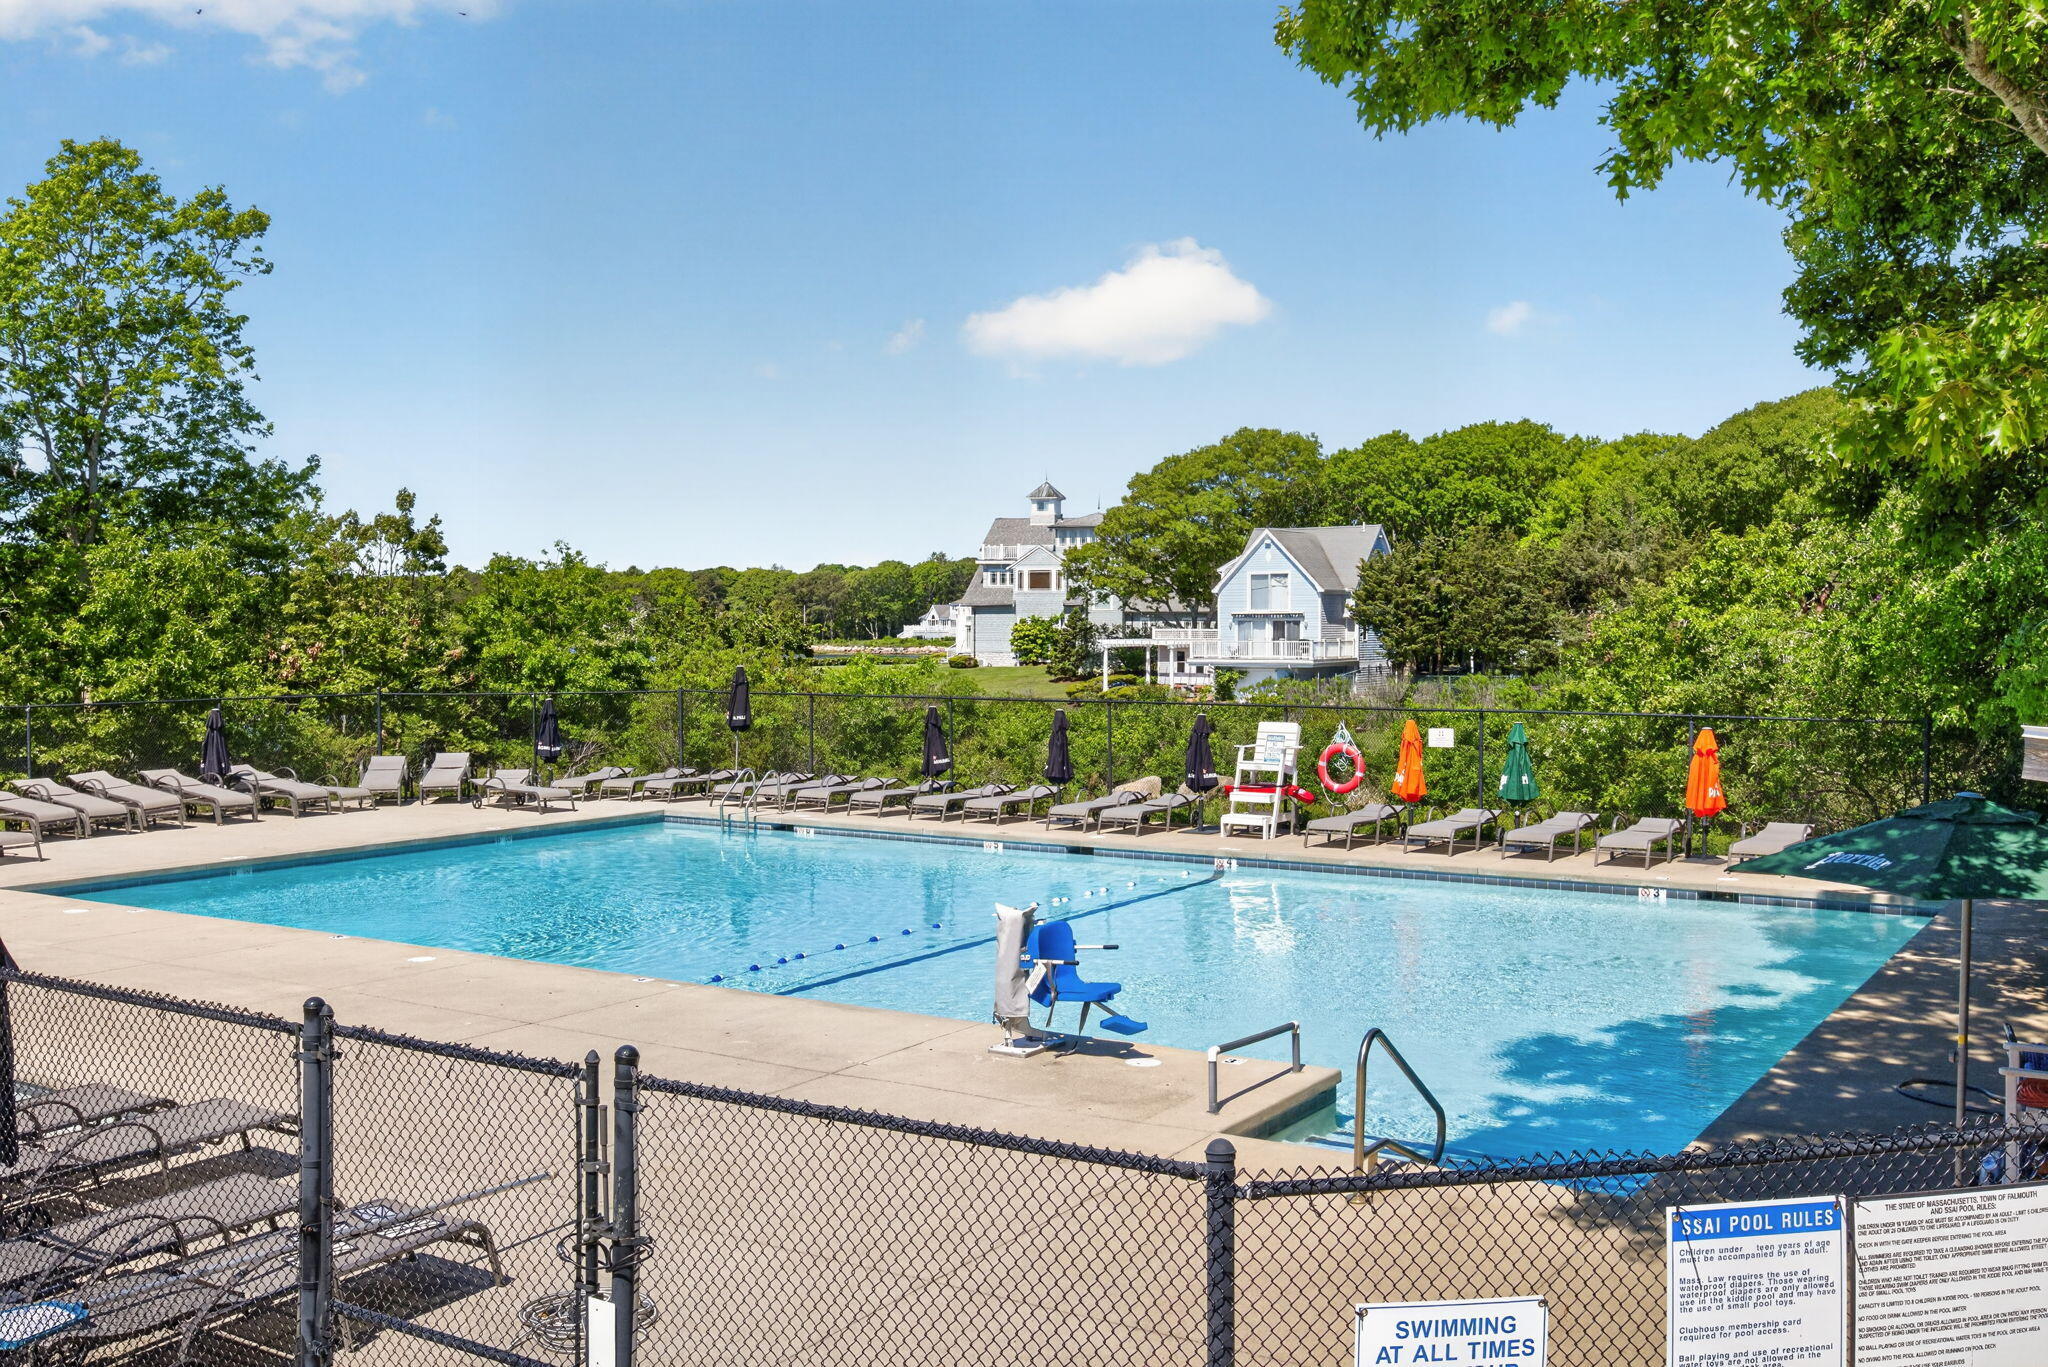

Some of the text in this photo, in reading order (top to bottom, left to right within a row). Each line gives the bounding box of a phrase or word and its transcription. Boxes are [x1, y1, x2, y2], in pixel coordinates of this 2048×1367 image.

[1653, 888, 1660, 898] 3
[1899, 1202, 1916, 1210] STATE
[1980, 1194, 1997, 1202] TOWN
[2008, 1191, 2037, 1200] FALMOUTH
[1682, 1210, 1833, 1236] SSAI POOL RULES
[1680, 1247, 1715, 1257] Children
[1719, 1246, 1743, 1254] under
[1778, 1242, 1800, 1251] years
[1816, 1240, 1830, 1249] age
[1718, 1250, 1774, 1262] accompanied
[1778, 1250, 1786, 1258] by
[1680, 1274, 1829, 1293] waterproof diapers. Those wearing
[1728, 1273, 1763, 1283] requires
[1680, 1289, 1726, 1300] waterproof
[1730, 1287, 1761, 1296] diapers
[1783, 1284, 1799, 1292] only
[1803, 1282, 1834, 1290] allowed
[1757, 1293, 1775, 1302] pool
[1754, 1300, 1772, 1309] pool
[1776, 1299, 1795, 1307] toys.
[1396, 1316, 1517, 1339] SWIMMING
[1680, 1324, 1724, 1334] Clubhouse
[1728, 1320, 1779, 1331] membership
[1680, 1332, 1715, 1343] required
[1735, 1329, 1754, 1338] pool
[1758, 1327, 1789, 1335] access.
[1376, 1338, 1535, 1364] AT ALL TIMES
[1700, 1352, 1729, 1362] playing
[1783, 1343, 1833, 1354] recreational
[1707, 1359, 1724, 1367] toys
[1762, 1353, 1794, 1362] allowed
